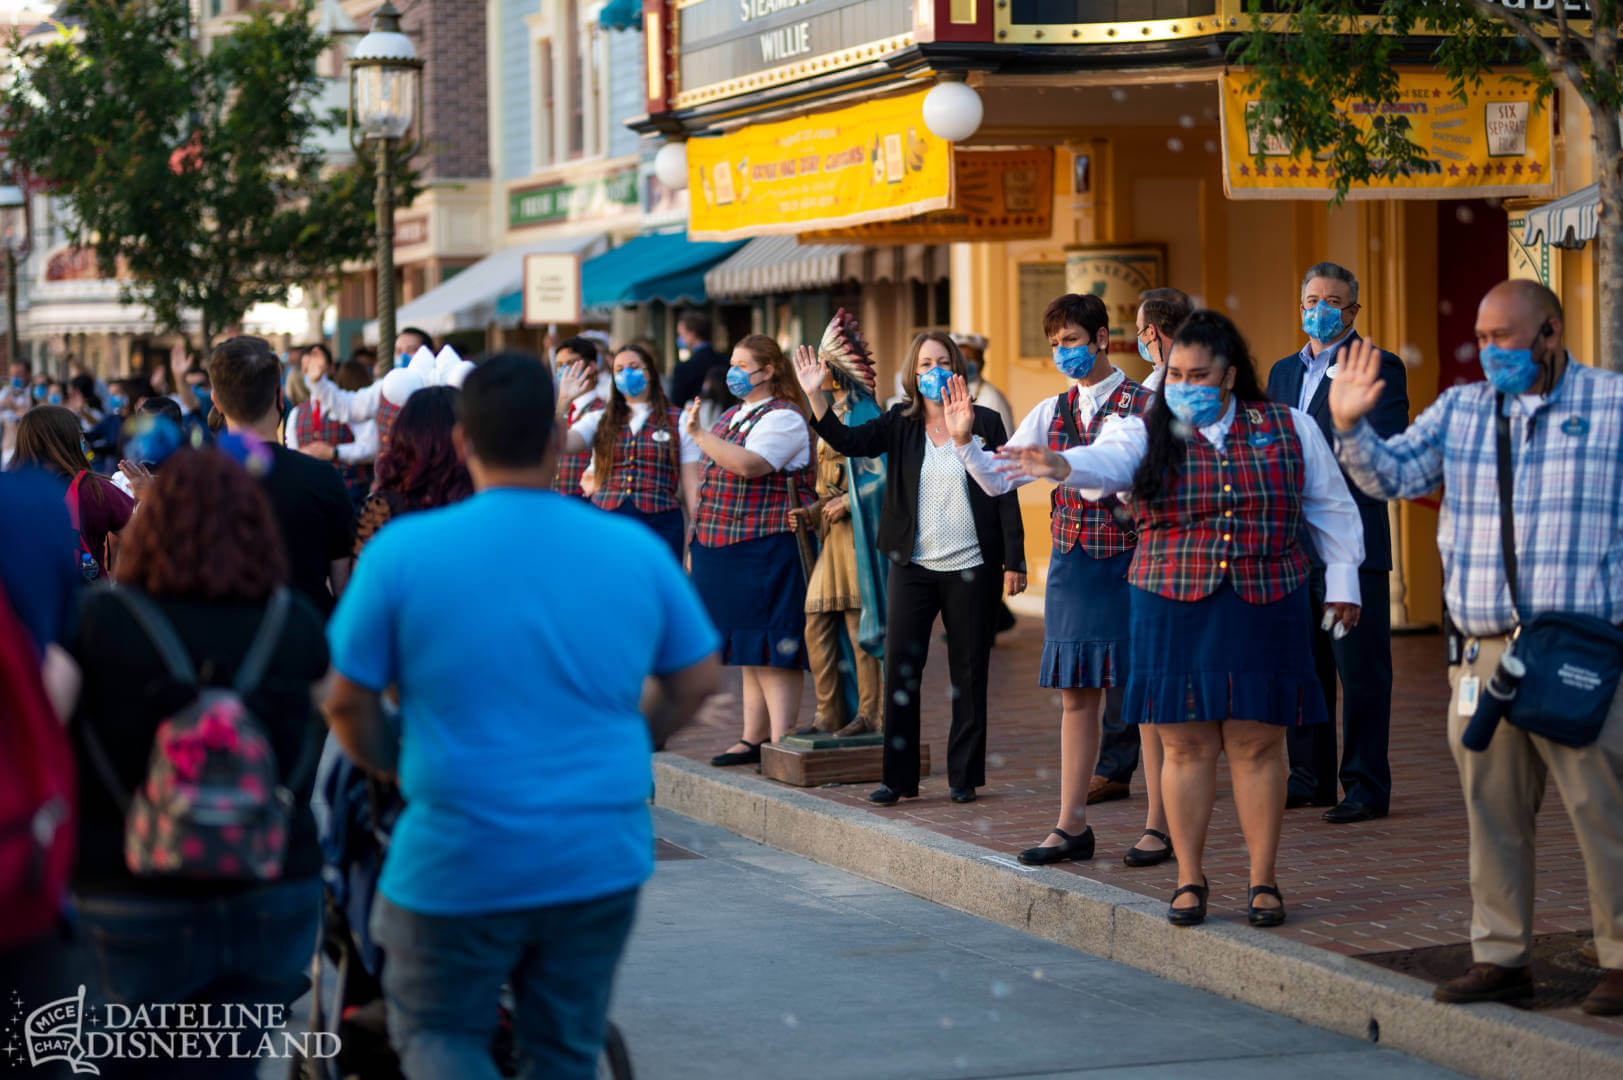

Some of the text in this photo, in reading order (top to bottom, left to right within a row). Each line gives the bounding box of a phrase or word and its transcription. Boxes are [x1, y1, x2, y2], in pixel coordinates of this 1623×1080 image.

[760, 22, 811, 63] WILLIE
[1380, 102, 1428, 114] DISNEY'S
[1498, 104, 1517, 118] SIX
